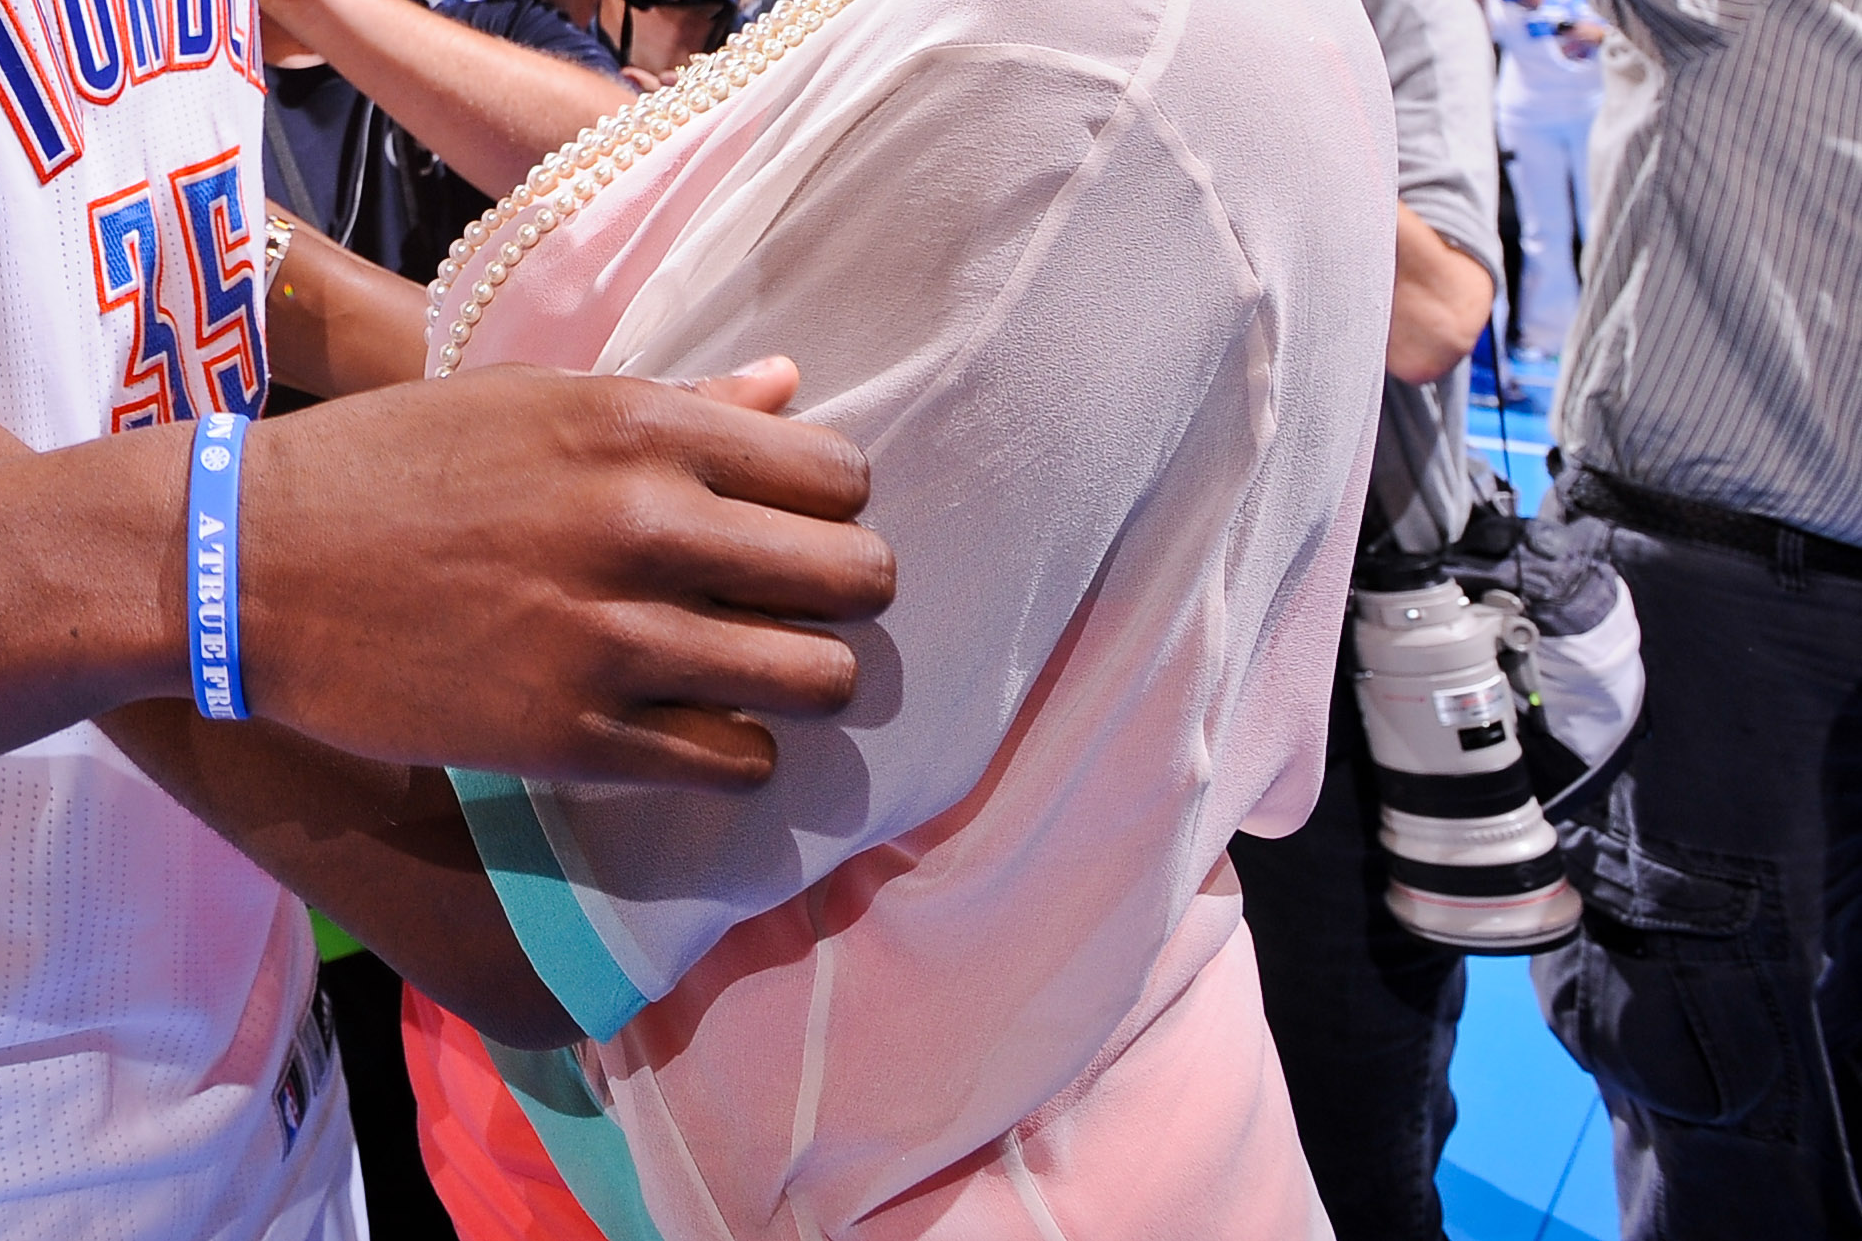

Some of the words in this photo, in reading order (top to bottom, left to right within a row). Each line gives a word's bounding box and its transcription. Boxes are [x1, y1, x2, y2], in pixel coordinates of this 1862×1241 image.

[87, 145, 269, 434] 35
[198, 511, 226, 541] A
[198, 543, 228, 660] TRUE
